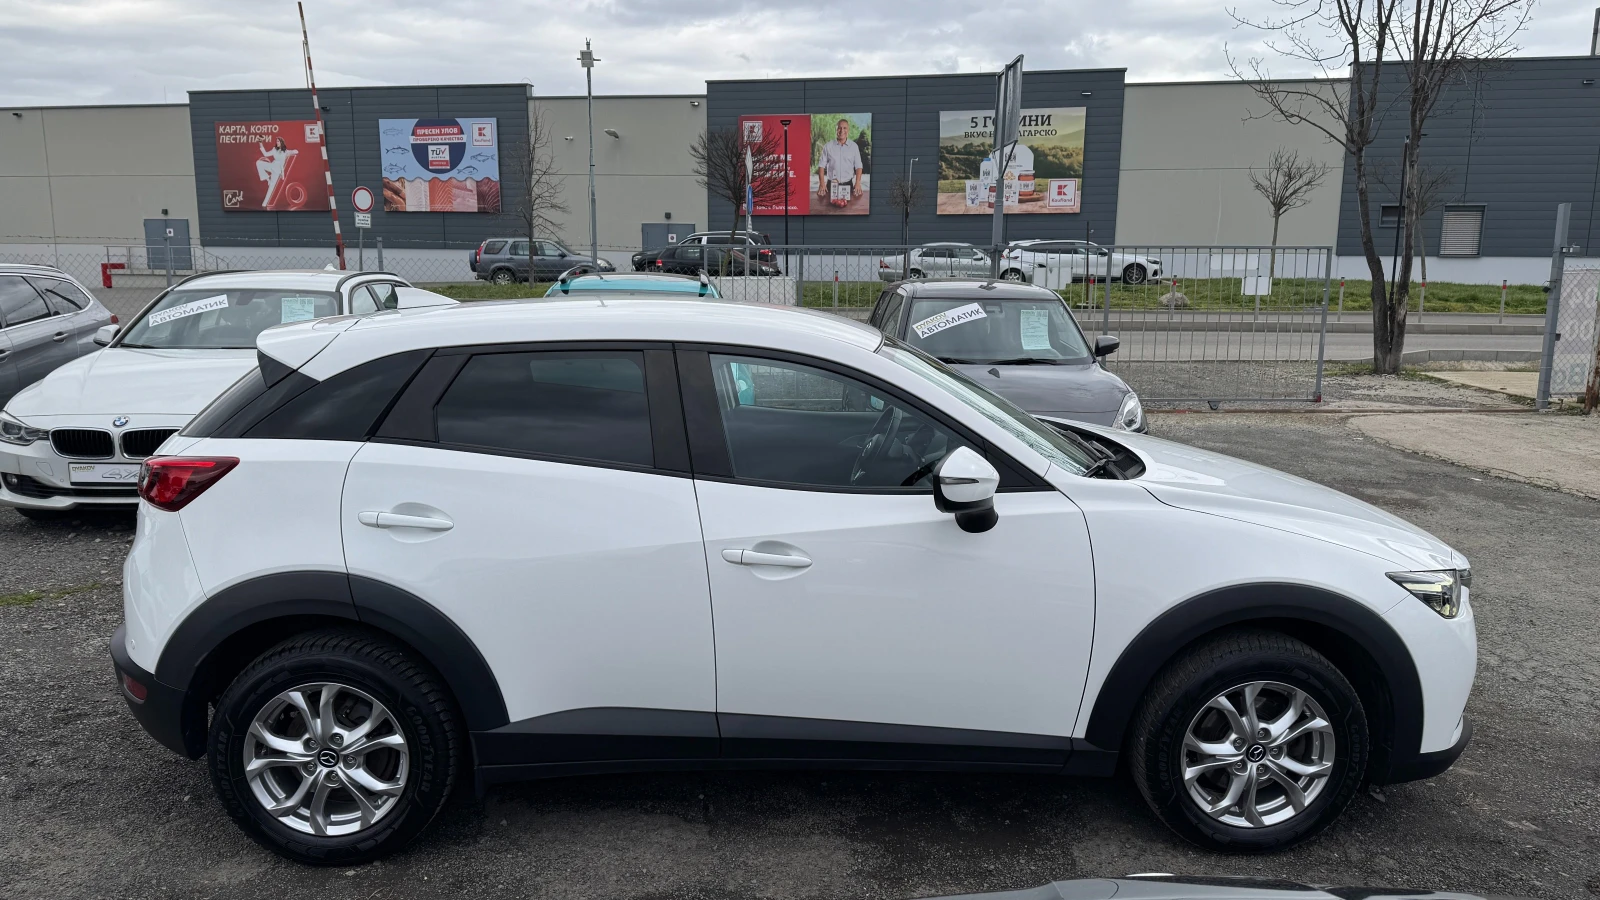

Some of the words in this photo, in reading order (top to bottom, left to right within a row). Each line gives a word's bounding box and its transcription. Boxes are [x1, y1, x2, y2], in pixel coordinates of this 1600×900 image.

[970, 116, 978, 128] 5
[982, 114, 1052, 128] ГИНИ
[218, 125, 248, 135] КАРТА,
[250, 125, 279, 133] КОЯТО
[219, 135, 246, 144] ПЕСТИ
[430, 147, 447, 156] TÜV
[226, 190, 244, 206] Card
[151, 299, 227, 325] АВТОМАТИК
[916, 312, 946, 330] DYAKOV
[921, 308, 983, 337] АВТОМАТИК
[406, 706, 434, 792] GOODYEAR
